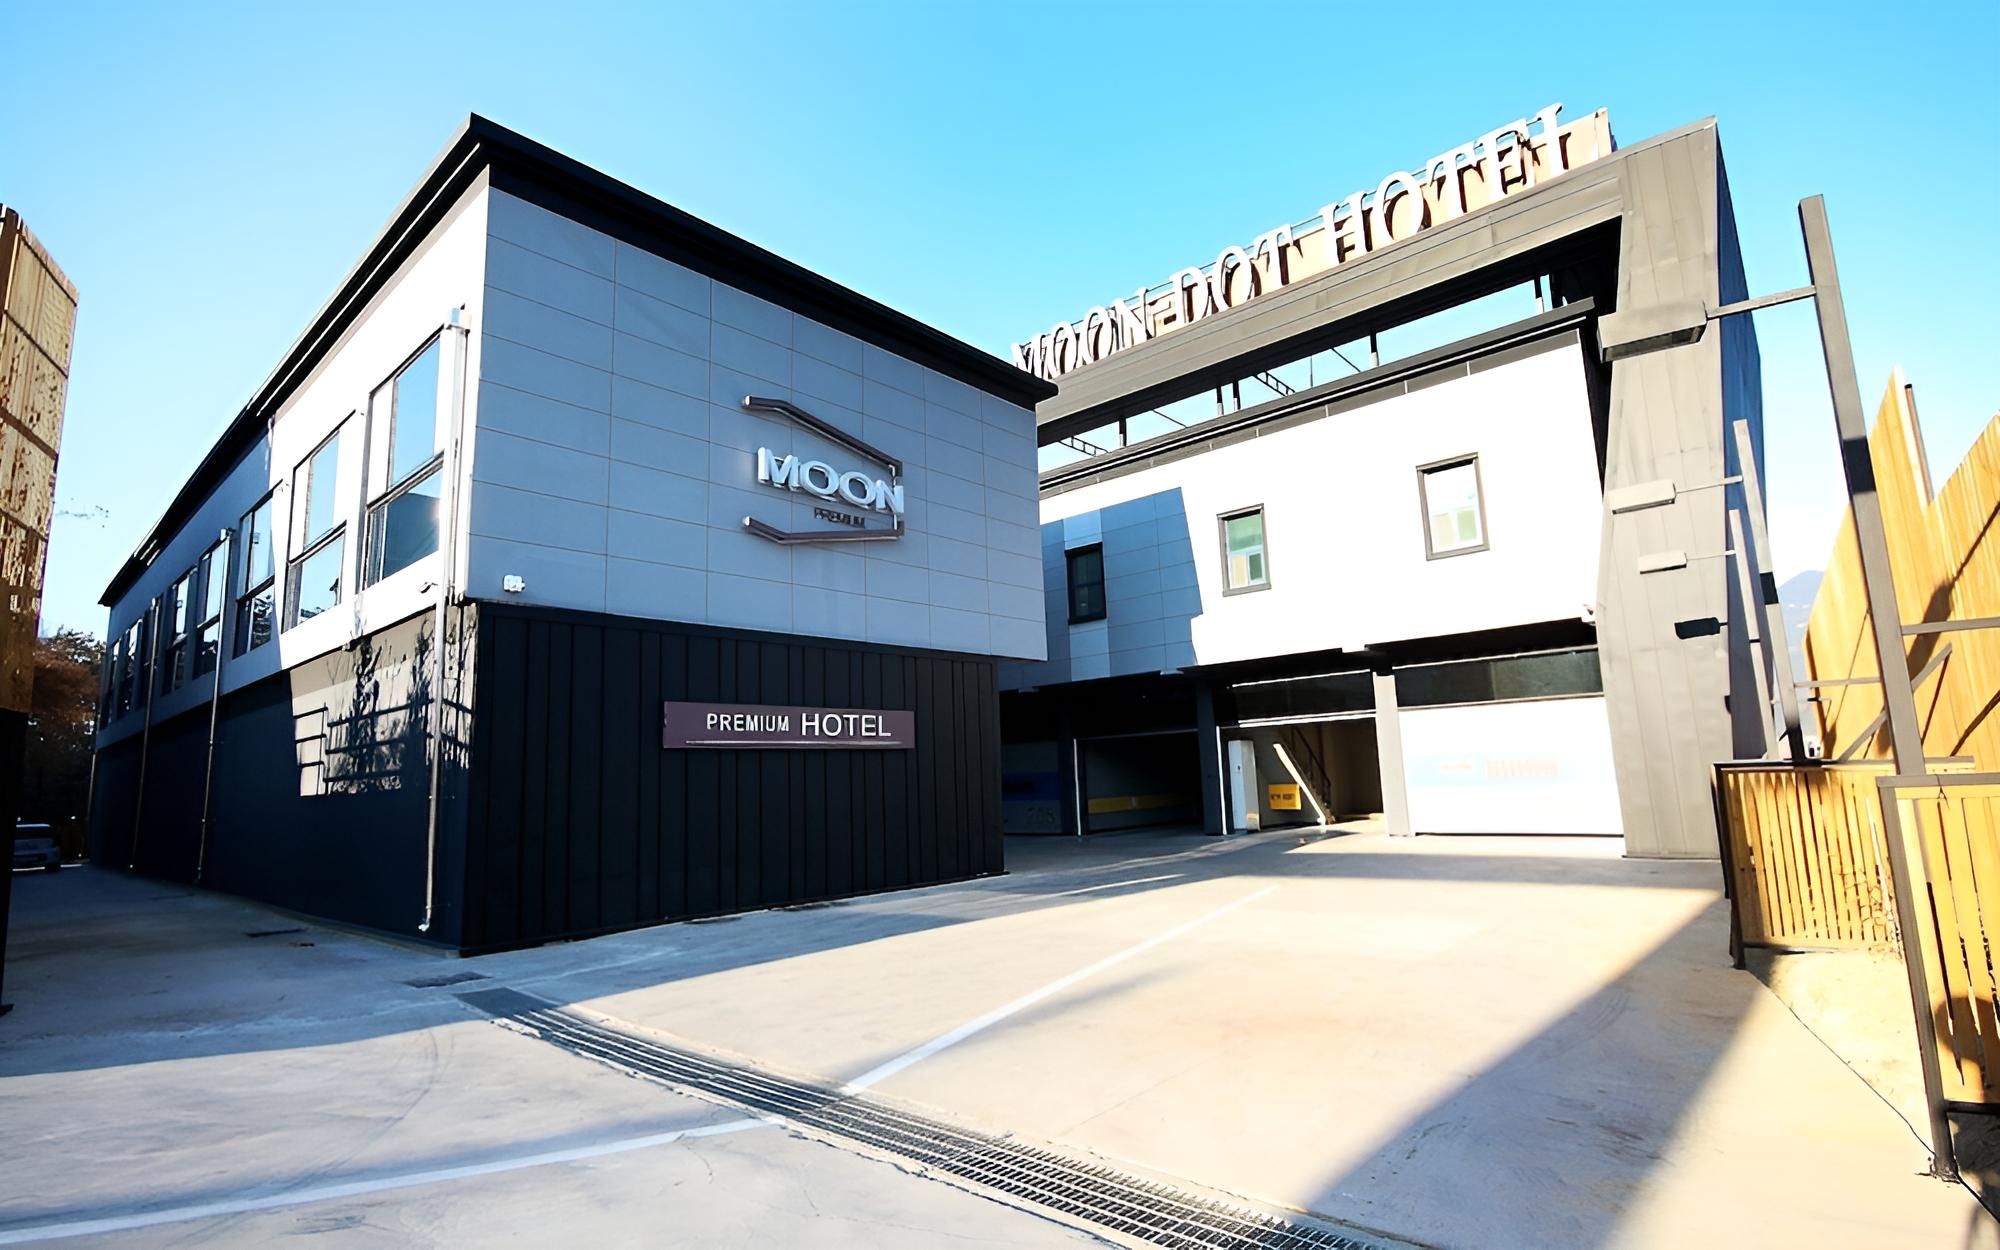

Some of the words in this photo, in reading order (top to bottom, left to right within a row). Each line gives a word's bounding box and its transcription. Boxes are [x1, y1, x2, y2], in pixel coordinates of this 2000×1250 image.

[757, 447, 904, 515] MOON
[706, 712, 790, 733] PREMIUM
[801, 712, 892, 737] HOTEL
